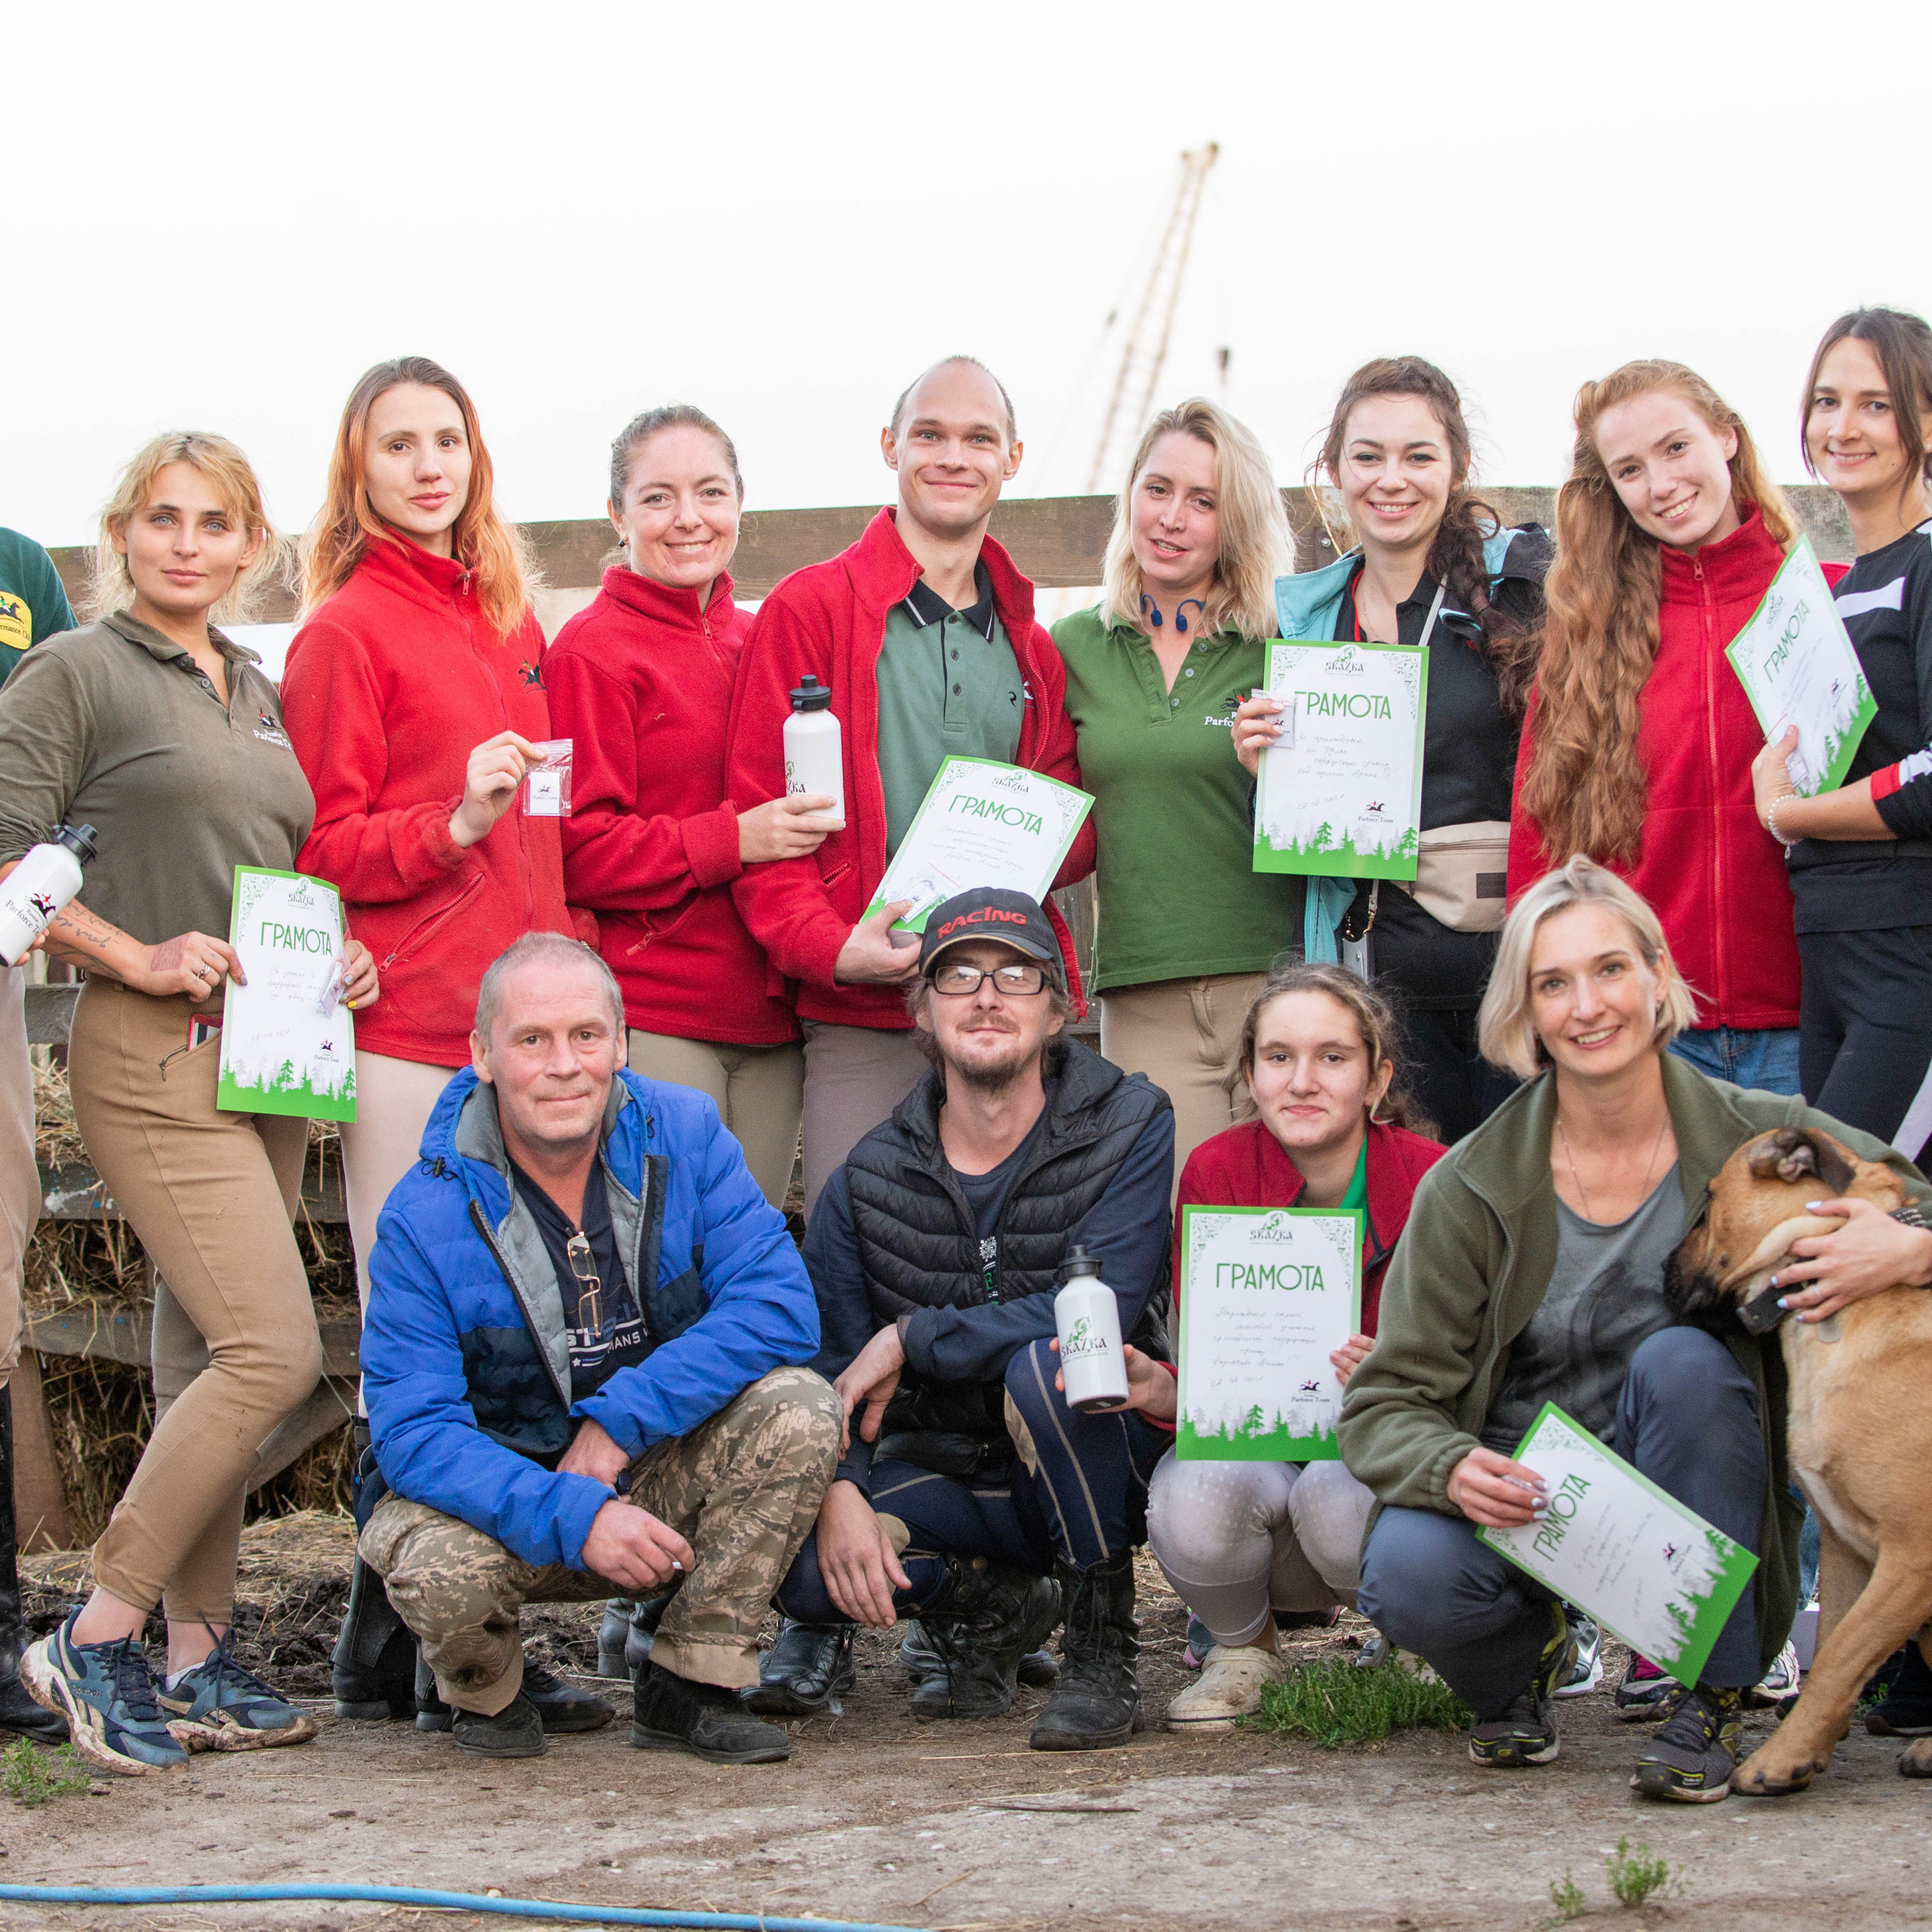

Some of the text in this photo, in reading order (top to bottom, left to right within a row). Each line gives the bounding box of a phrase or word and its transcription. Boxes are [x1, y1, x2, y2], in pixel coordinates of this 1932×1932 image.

[1763, 599, 1810, 683] ГРАМОТА
[1324, 661, 1364, 673] SKAZKA
[1204, 715, 1235, 728] Parfo
[948, 795, 1043, 835] ГРАМОТА
[288, 893, 315, 906] SKAZKA
[5, 899, 41, 937] Parforce Te
[937, 906, 1027, 941] RACING
[260, 921, 333, 957] ГРАМОТА
[1250, 1229, 1294, 1241] SKAZKA
[1216, 1263, 1324, 1291] ГРАМОТА
[1061, 1338, 1107, 1358] SKAZKA
[1532, 1473, 1592, 1563] ГРАМОТА
